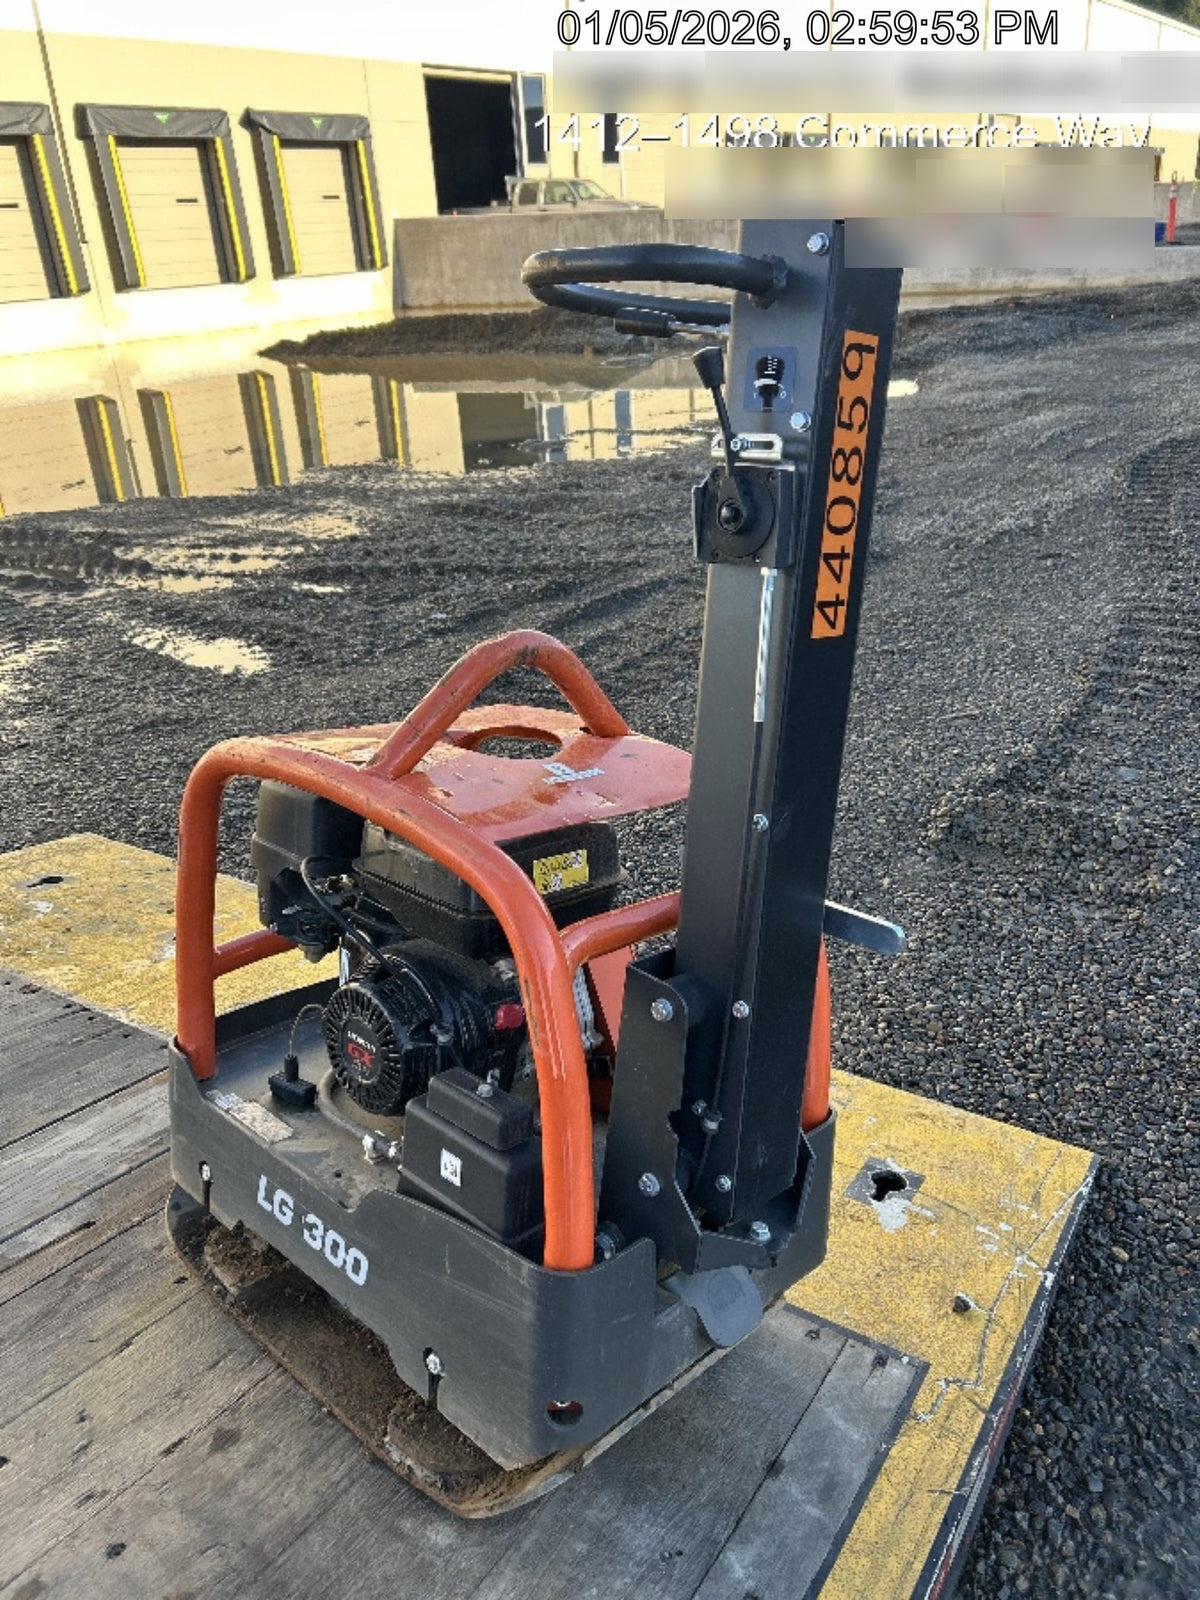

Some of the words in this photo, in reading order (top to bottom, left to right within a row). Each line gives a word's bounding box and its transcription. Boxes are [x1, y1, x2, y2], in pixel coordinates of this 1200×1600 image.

[816, 342, 876, 630] 440859
[256, 1173, 294, 1226] LG
[302, 1212, 369, 1286] 300
